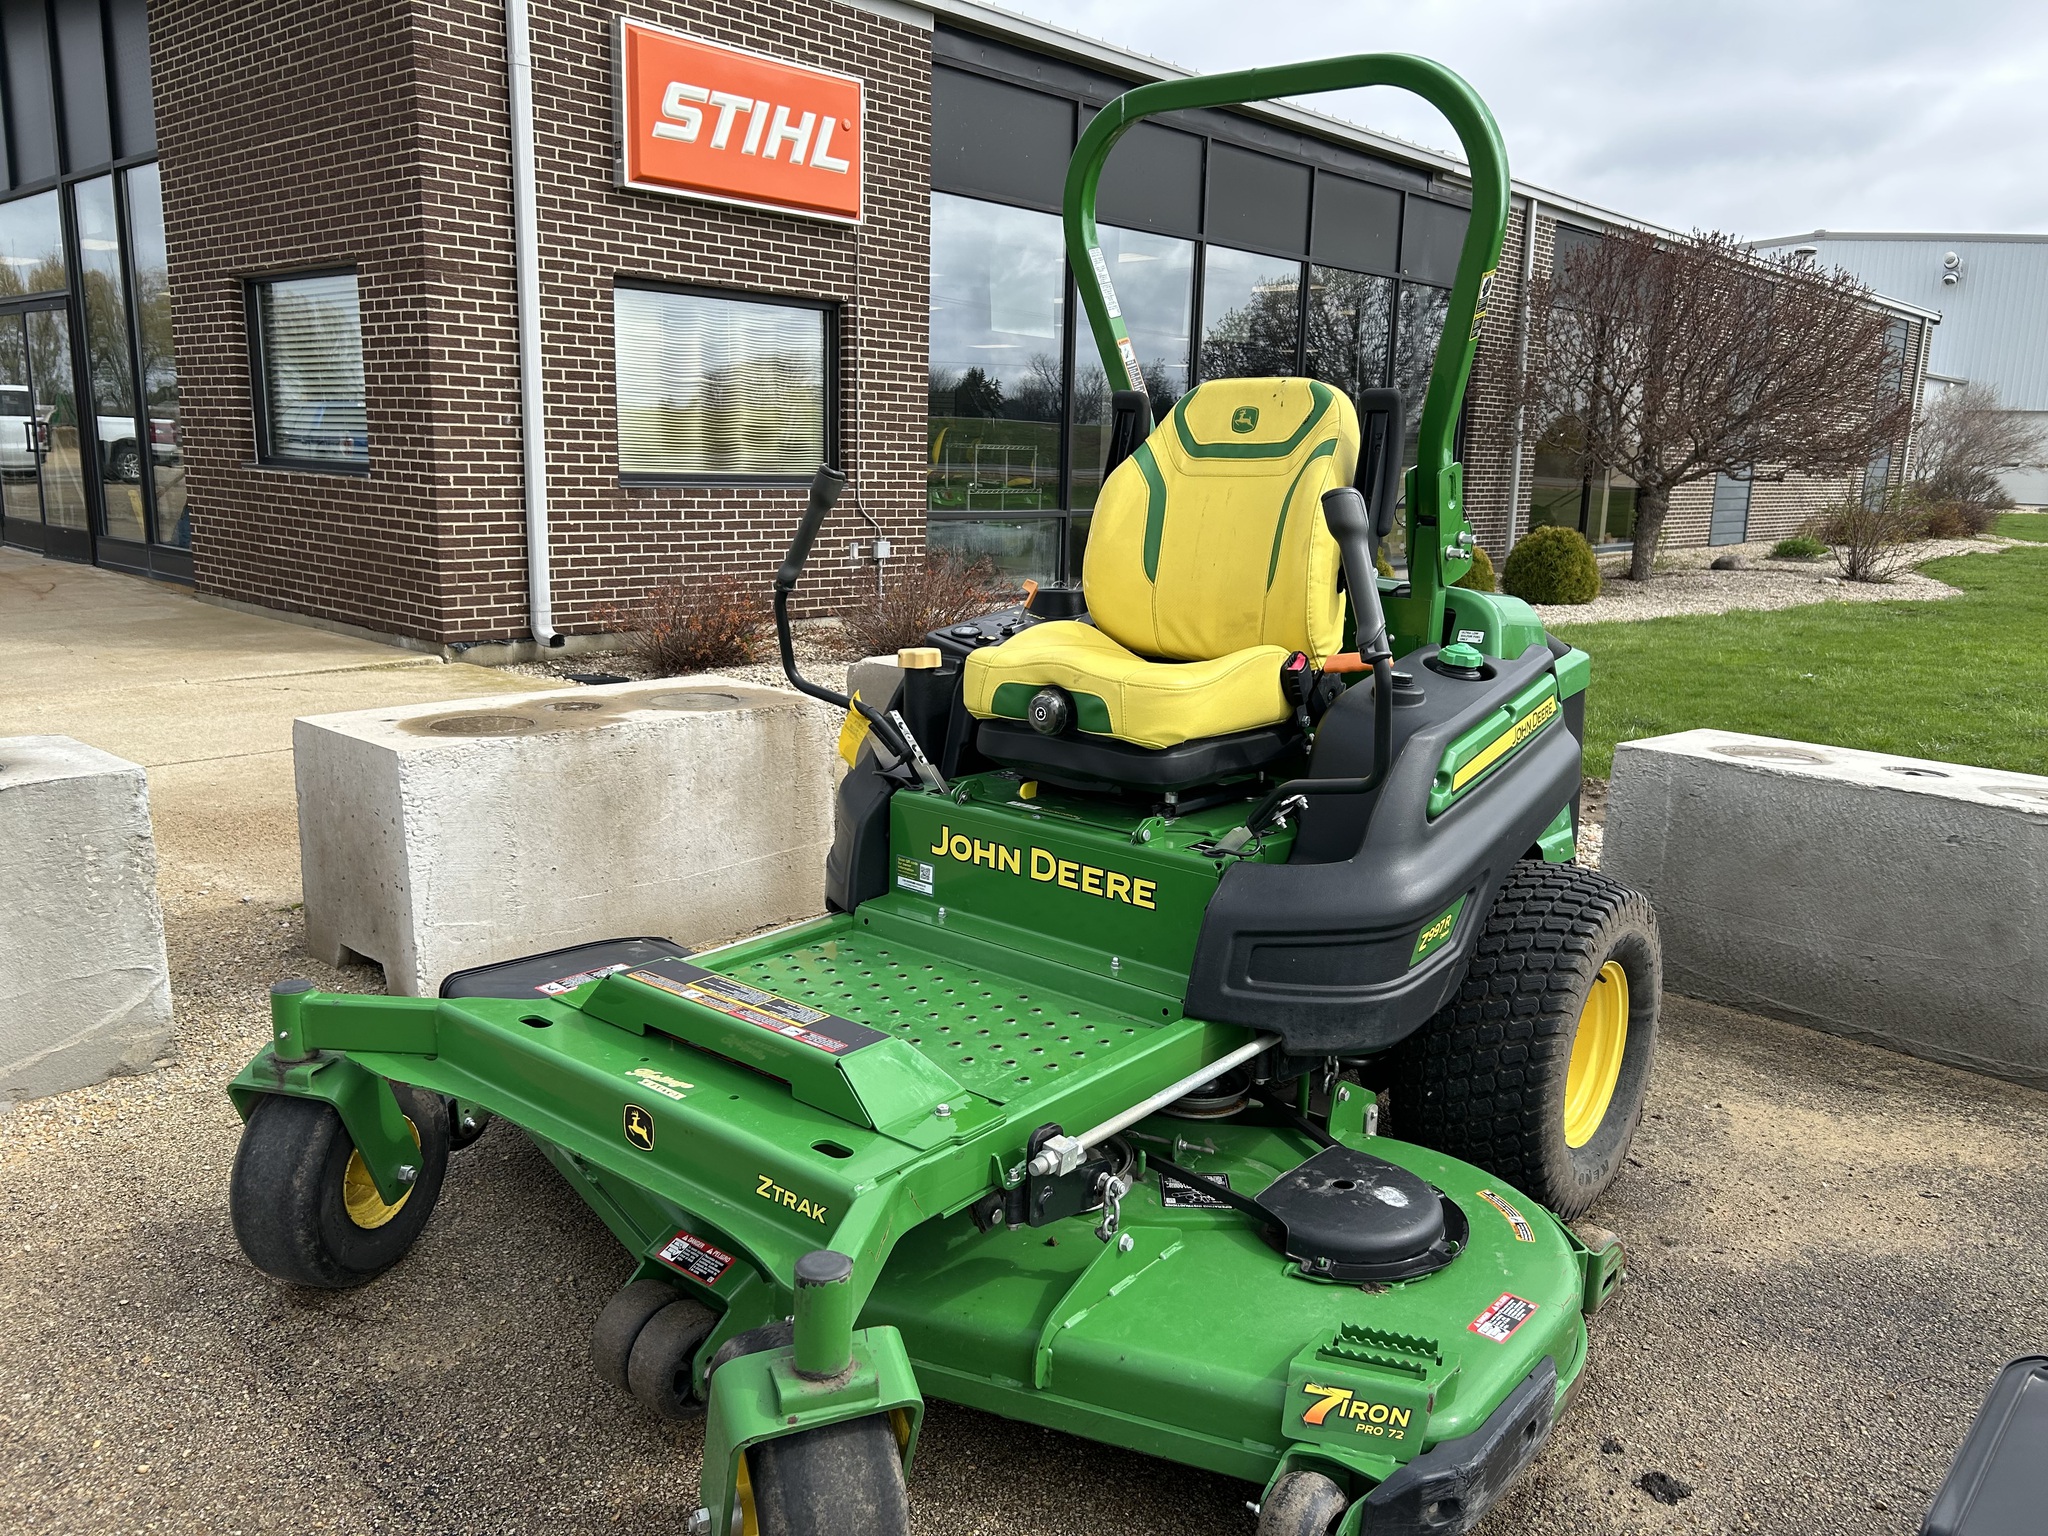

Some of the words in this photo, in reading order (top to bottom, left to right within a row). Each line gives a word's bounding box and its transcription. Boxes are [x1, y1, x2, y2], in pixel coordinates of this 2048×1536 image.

[652, 81, 850, 174] STIHL
[1512, 718, 1532, 746] JOHN
[1532, 701, 1553, 729] DEERE
[930, 824, 1021, 877] JOHN
[1029, 846, 1157, 911] DEERE
[755, 1173, 828, 1225] ZTRAK
[688, 1236, 706, 1249] DANGER
[712, 1250, 731, 1263] PELIGRO
[1355, 1423, 1384, 1436] PRO
[1387, 1428, 1405, 1440] 72
